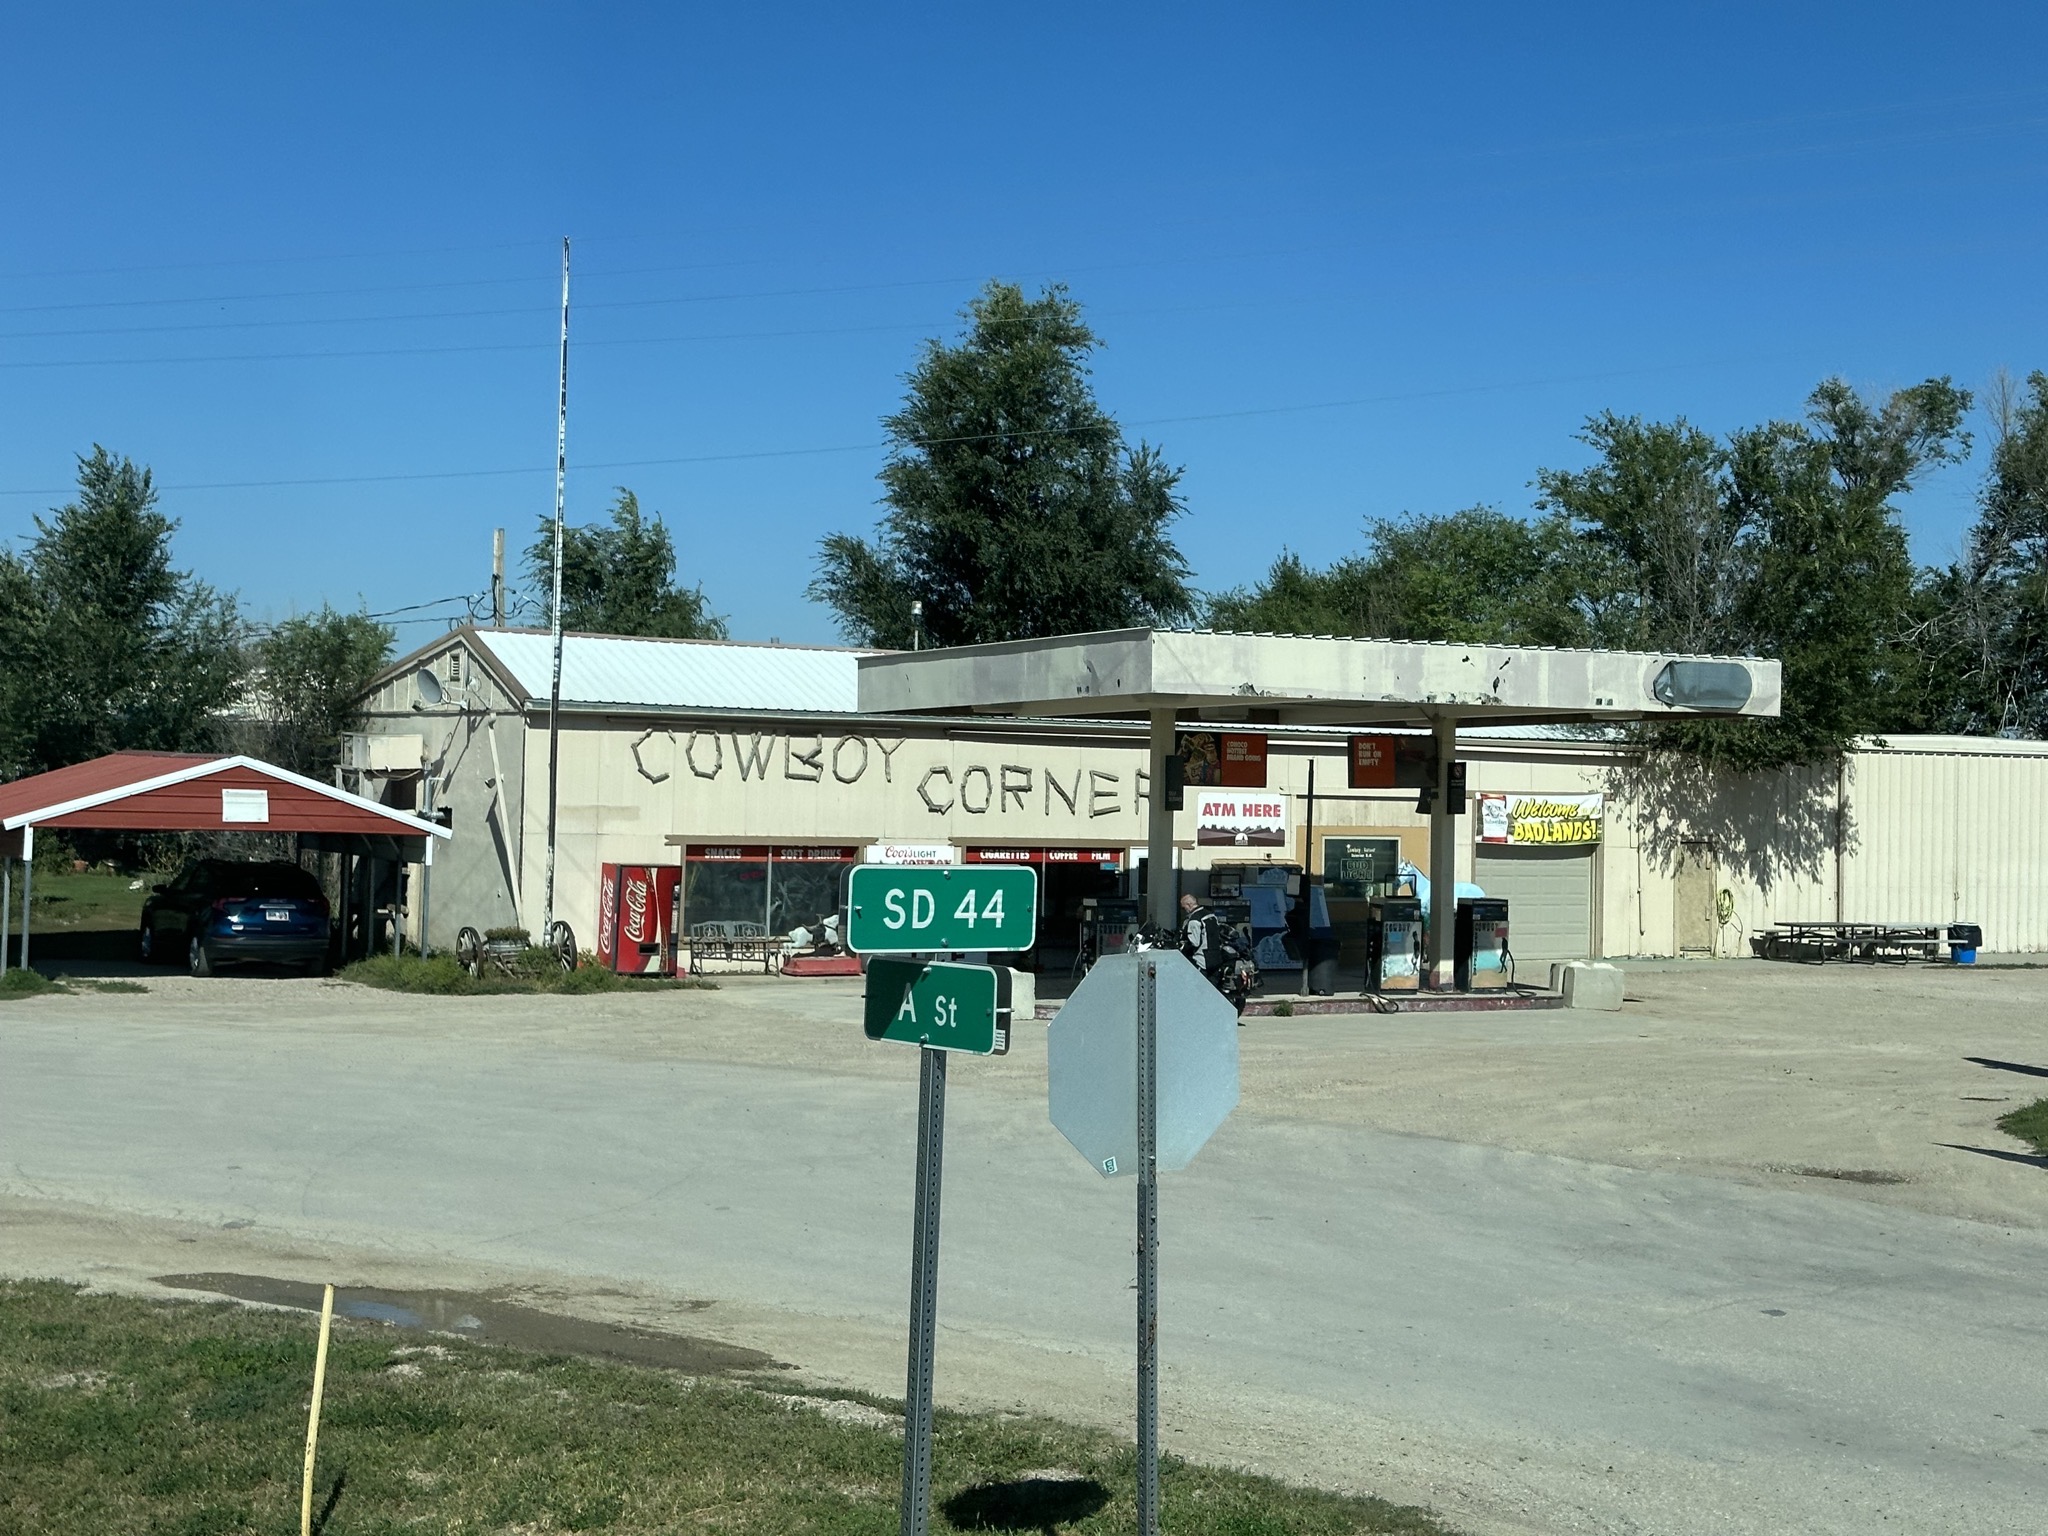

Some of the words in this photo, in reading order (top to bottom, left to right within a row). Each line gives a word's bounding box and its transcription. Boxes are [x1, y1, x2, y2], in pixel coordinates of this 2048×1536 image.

[1358, 742, 1376, 750] DON'T
[631, 729, 907, 784] COWBOY
[1358, 750, 1371, 758] RUN
[1373, 750, 1382, 758] ON
[1358, 758, 1379, 766] EMPTY
[1202, 803, 1236, 817] ATM
[1242, 804, 1281, 818] HERE
[1511, 798, 1579, 820] Welcome
[1513, 820, 1598, 843] BADLANDS!
[704, 848, 741, 859] SNACKS
[781, 849, 803, 860] SOFT
[807, 849, 842, 860] DRINKS
[980, 849, 1030, 859] CIGARETTES
[1048, 850, 1078, 860] COFFEE
[1091, 850, 1111, 861] FILM
[882, 888, 937, 930] SD
[953, 889, 1006, 929] 44
[898, 982, 918, 1023] A
[934, 995, 959, 1028] St
